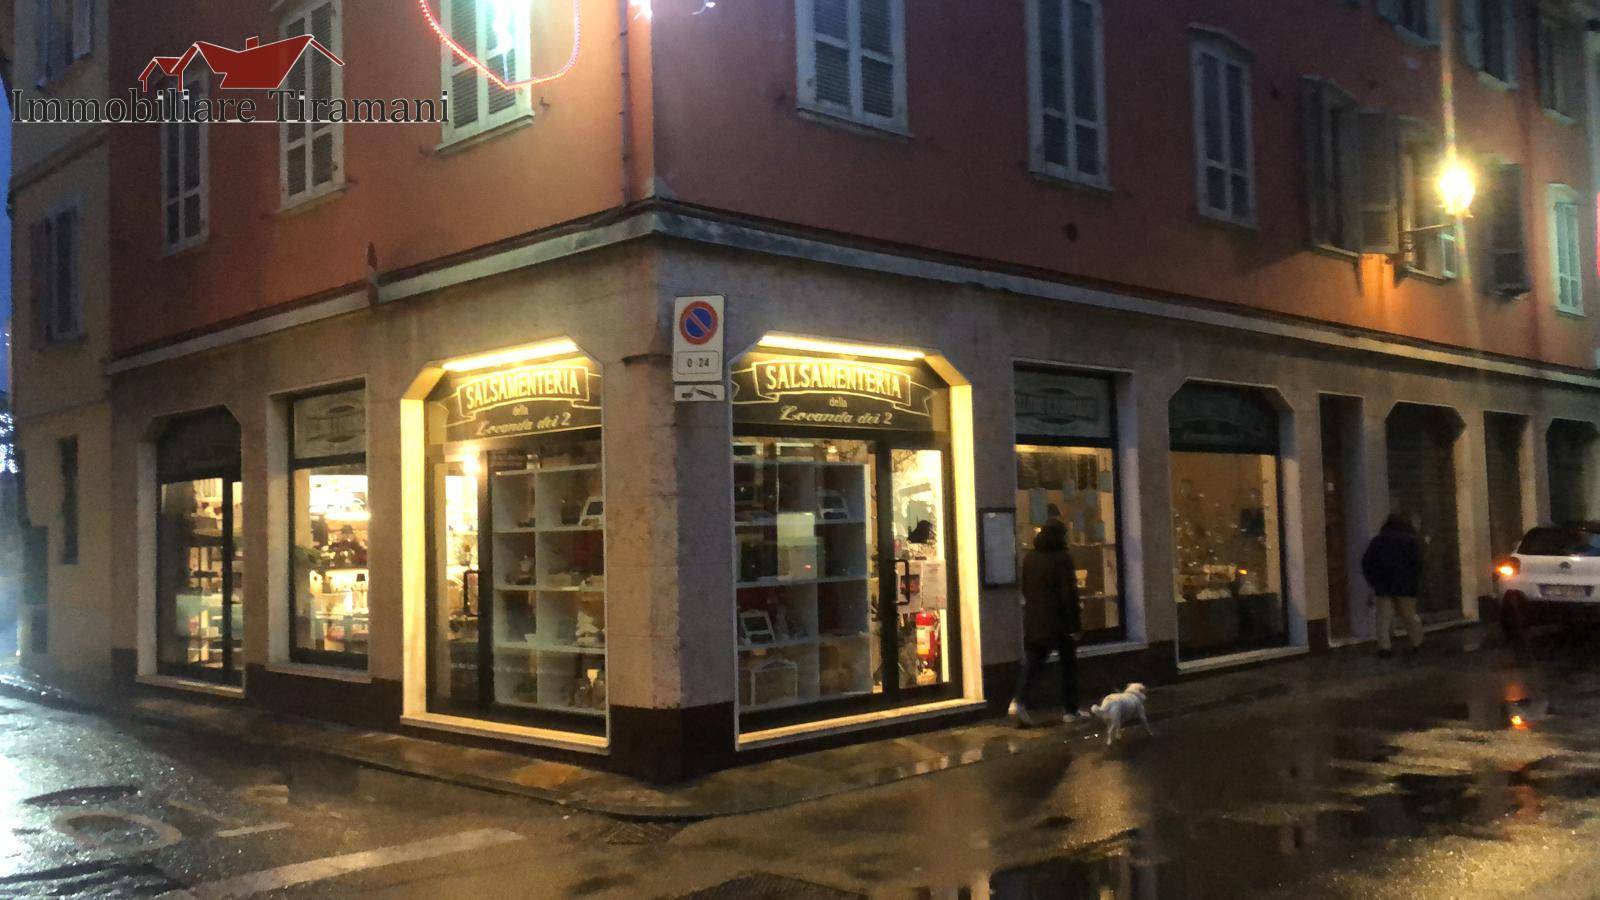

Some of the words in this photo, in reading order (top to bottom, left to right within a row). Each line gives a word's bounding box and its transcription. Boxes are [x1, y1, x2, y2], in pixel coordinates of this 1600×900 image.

[687, 358, 693, 368] 0
[698, 358, 710, 368] 24
[465, 367, 580, 409] SALSAMENTERIA
[765, 361, 902, 398] SALSAMENTERIA
[536, 414, 560, 430] dei
[561, 411, 572, 426] 2
[778, 405, 853, 424] Locanda
[857, 411, 881, 424] dei
[883, 411, 893, 425] 2
